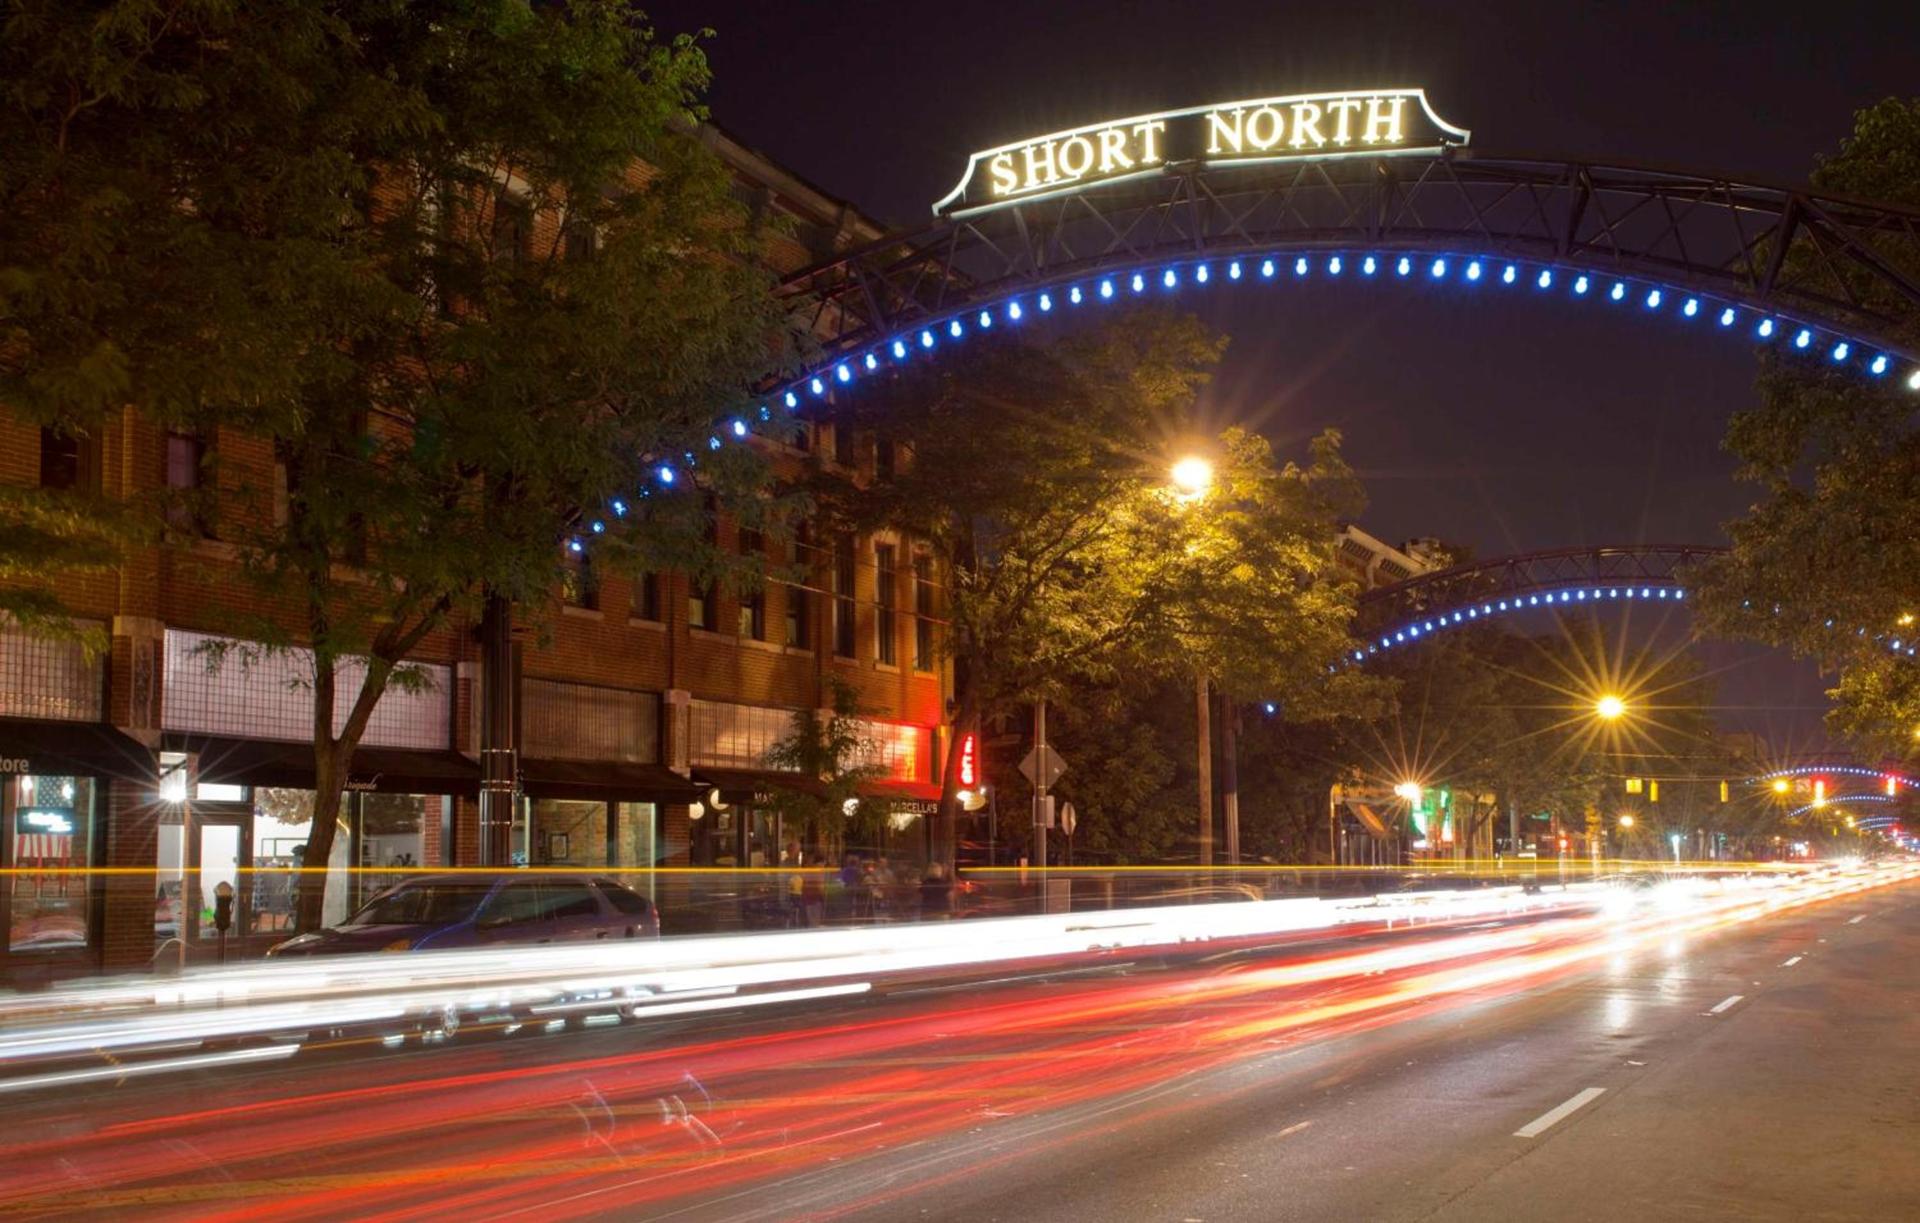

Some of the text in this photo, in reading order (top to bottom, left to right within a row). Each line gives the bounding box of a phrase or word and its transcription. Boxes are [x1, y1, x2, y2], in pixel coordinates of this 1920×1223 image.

[990, 98, 1407, 196] SHORT NORTH
[889, 802, 938, 814] MRCELLA'S
